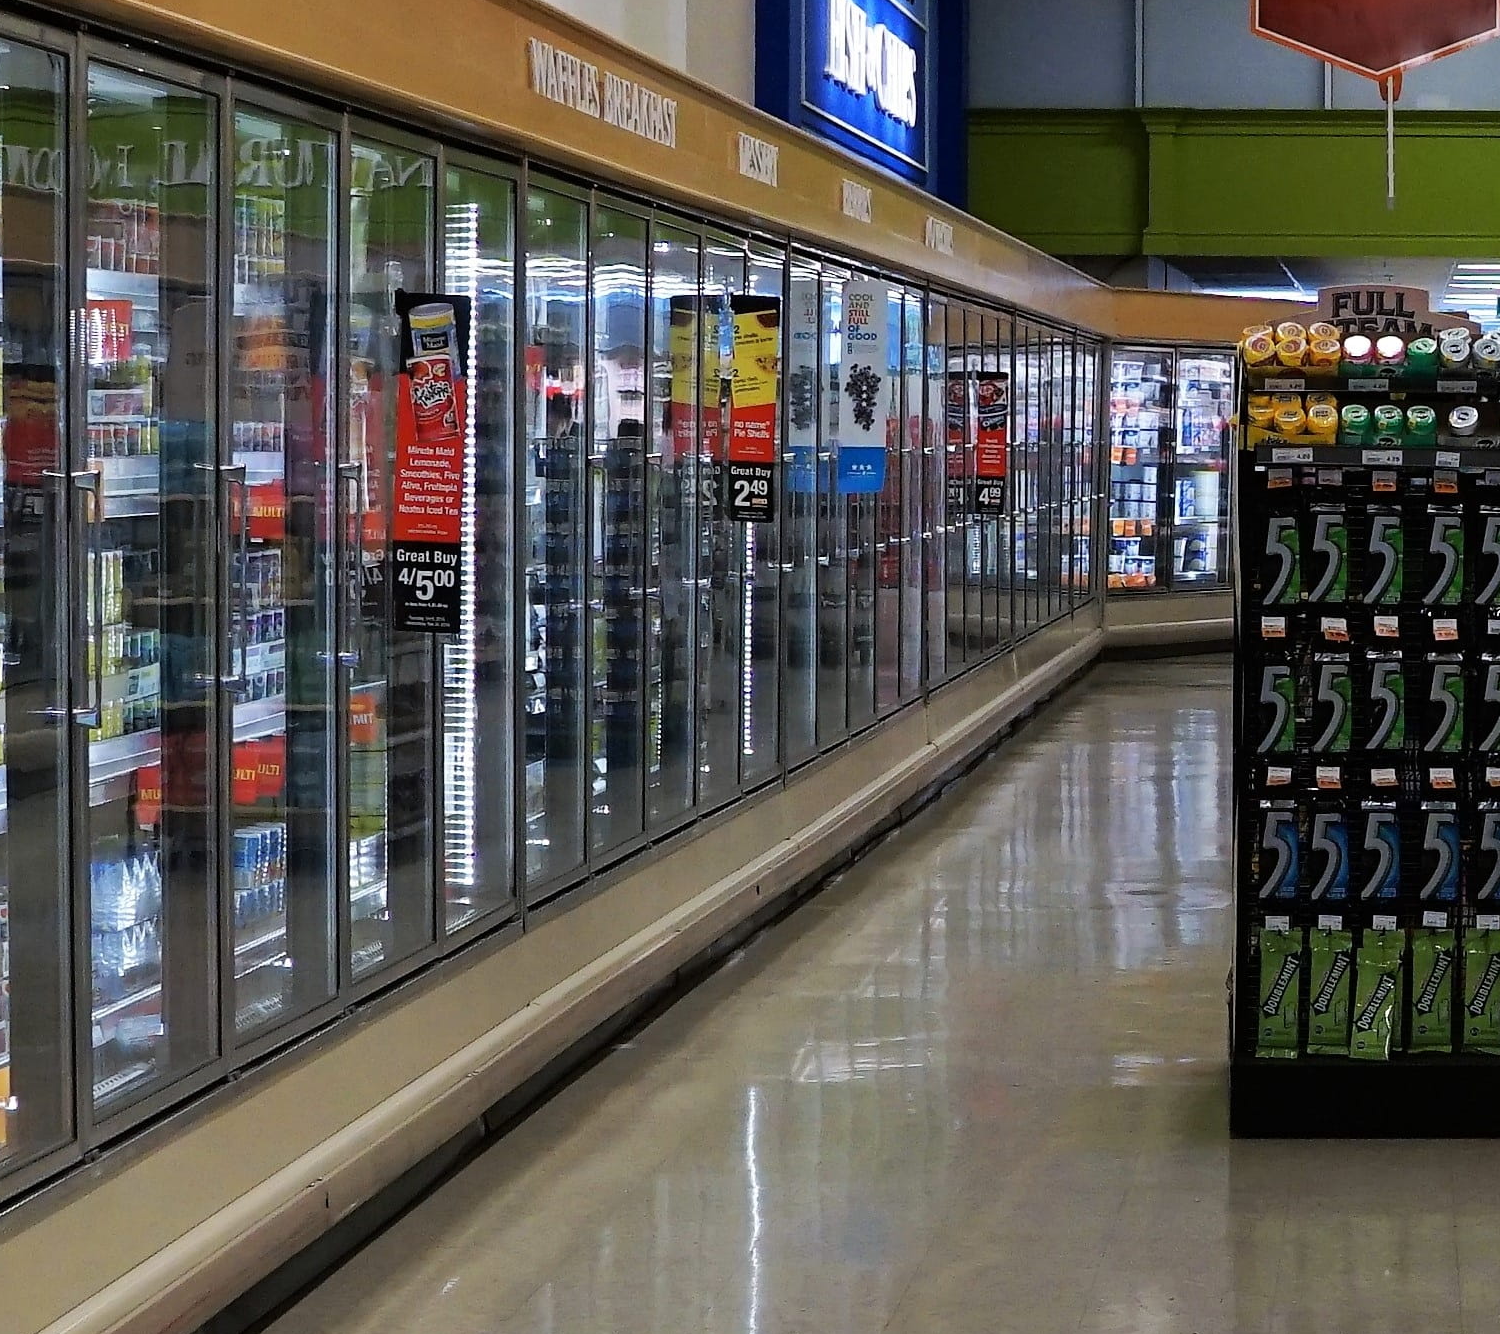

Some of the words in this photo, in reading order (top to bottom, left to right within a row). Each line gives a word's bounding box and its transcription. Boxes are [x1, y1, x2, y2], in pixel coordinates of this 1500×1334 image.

[529, 36, 601, 119] WAFFLES
[603, 69, 678, 148] BREAKFAST
[875, 25, 917, 128] CHIPS
[848, 333, 877, 341] GOOD
[849, 293, 874, 302] COOL
[1331, 291, 1415, 318] FULL
[435, 446, 455, 456] Maid
[731, 466, 752, 477] Great
[753, 467, 771, 478] Buy
[404, 493, 443, 504] Beverages
[397, 549, 431, 563] Great
[433, 550, 457, 566] Buy
[1263, 516, 1295, 605] 5
[1309, 514, 1345, 603] 5
[1364, 515, 1400, 604] 5
[1423, 516, 1462, 605] 5
[1257, 665, 1290, 753] 5
[1313, 665, 1348, 753] 5
[1366, 664, 1400, 750] 5
[1424, 665, 1461, 753] 5
[1259, 813, 1293, 900] 5
[1311, 813, 1345, 899] 5
[1361, 813, 1395, 900] 5
[1420, 813, 1454, 899] 5
[1264, 953, 1301, 1015] DOUBLEMINT
[1314, 953, 1350, 1013] DOUBLEMINT
[1357, 974, 1396, 1031] DOUBLEMINT
[1417, 953, 1453, 1013] DOUBLEMINT
